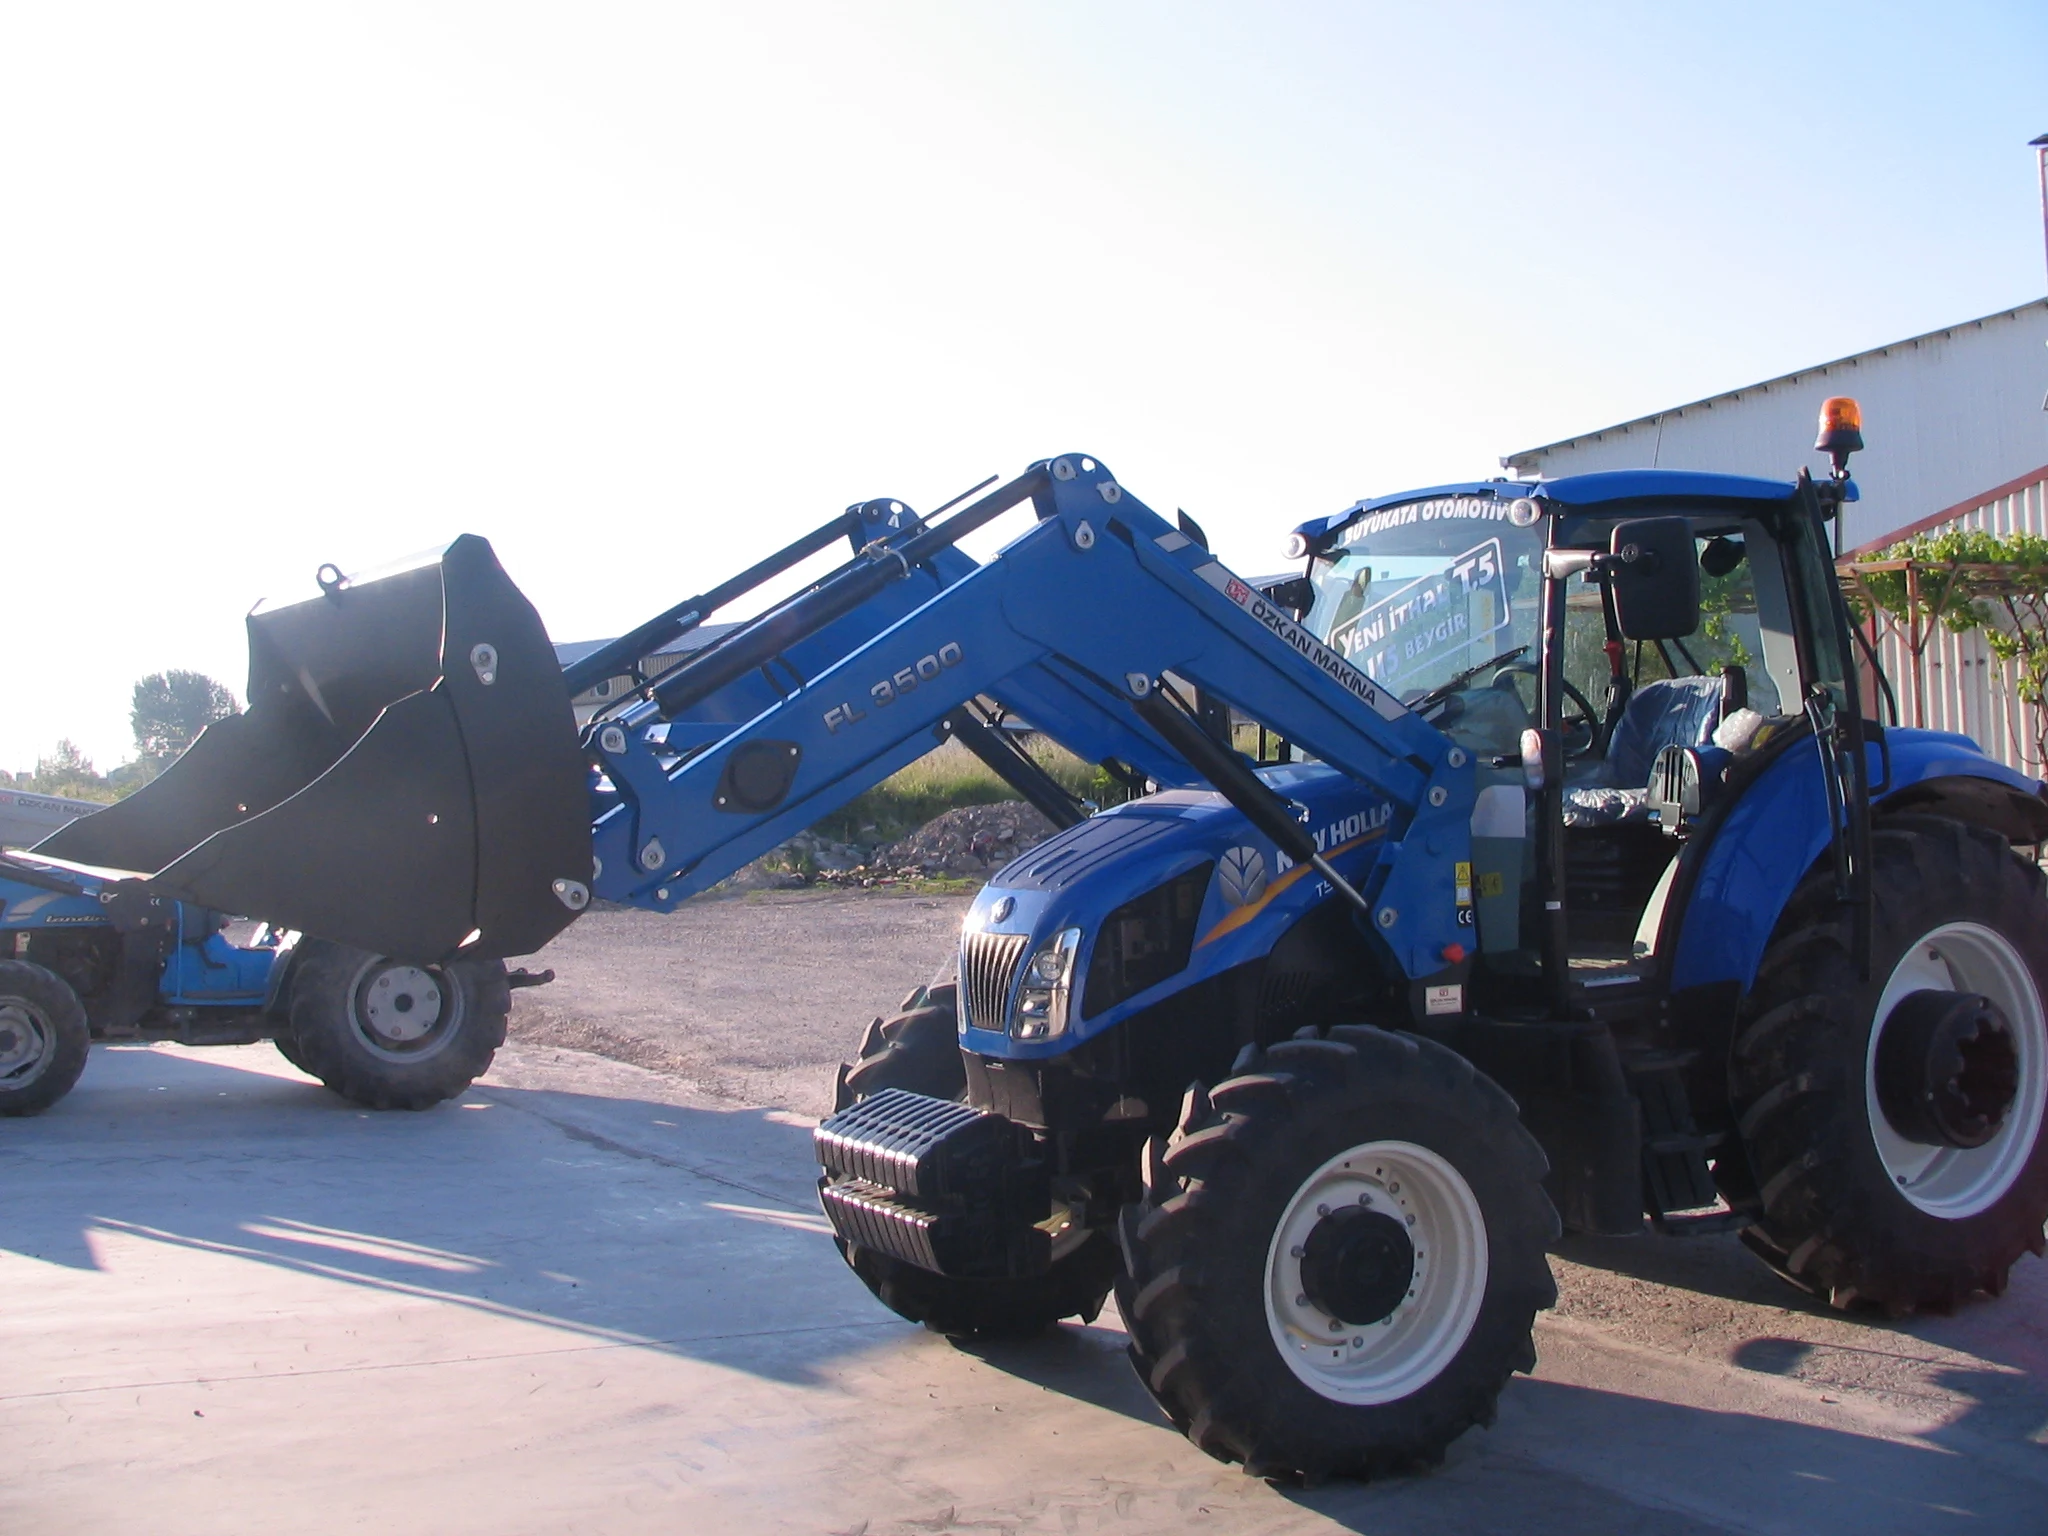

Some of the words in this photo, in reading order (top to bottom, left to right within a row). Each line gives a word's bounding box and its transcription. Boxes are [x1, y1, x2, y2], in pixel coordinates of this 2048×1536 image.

[823, 702, 866, 735] FL
[870, 642, 963, 708] 3500
[1252, 600, 1311, 655] ÖZKAN
[1313, 650, 1376, 705] MAKİNA
[1330, 802, 1395, 847] HOLLA
